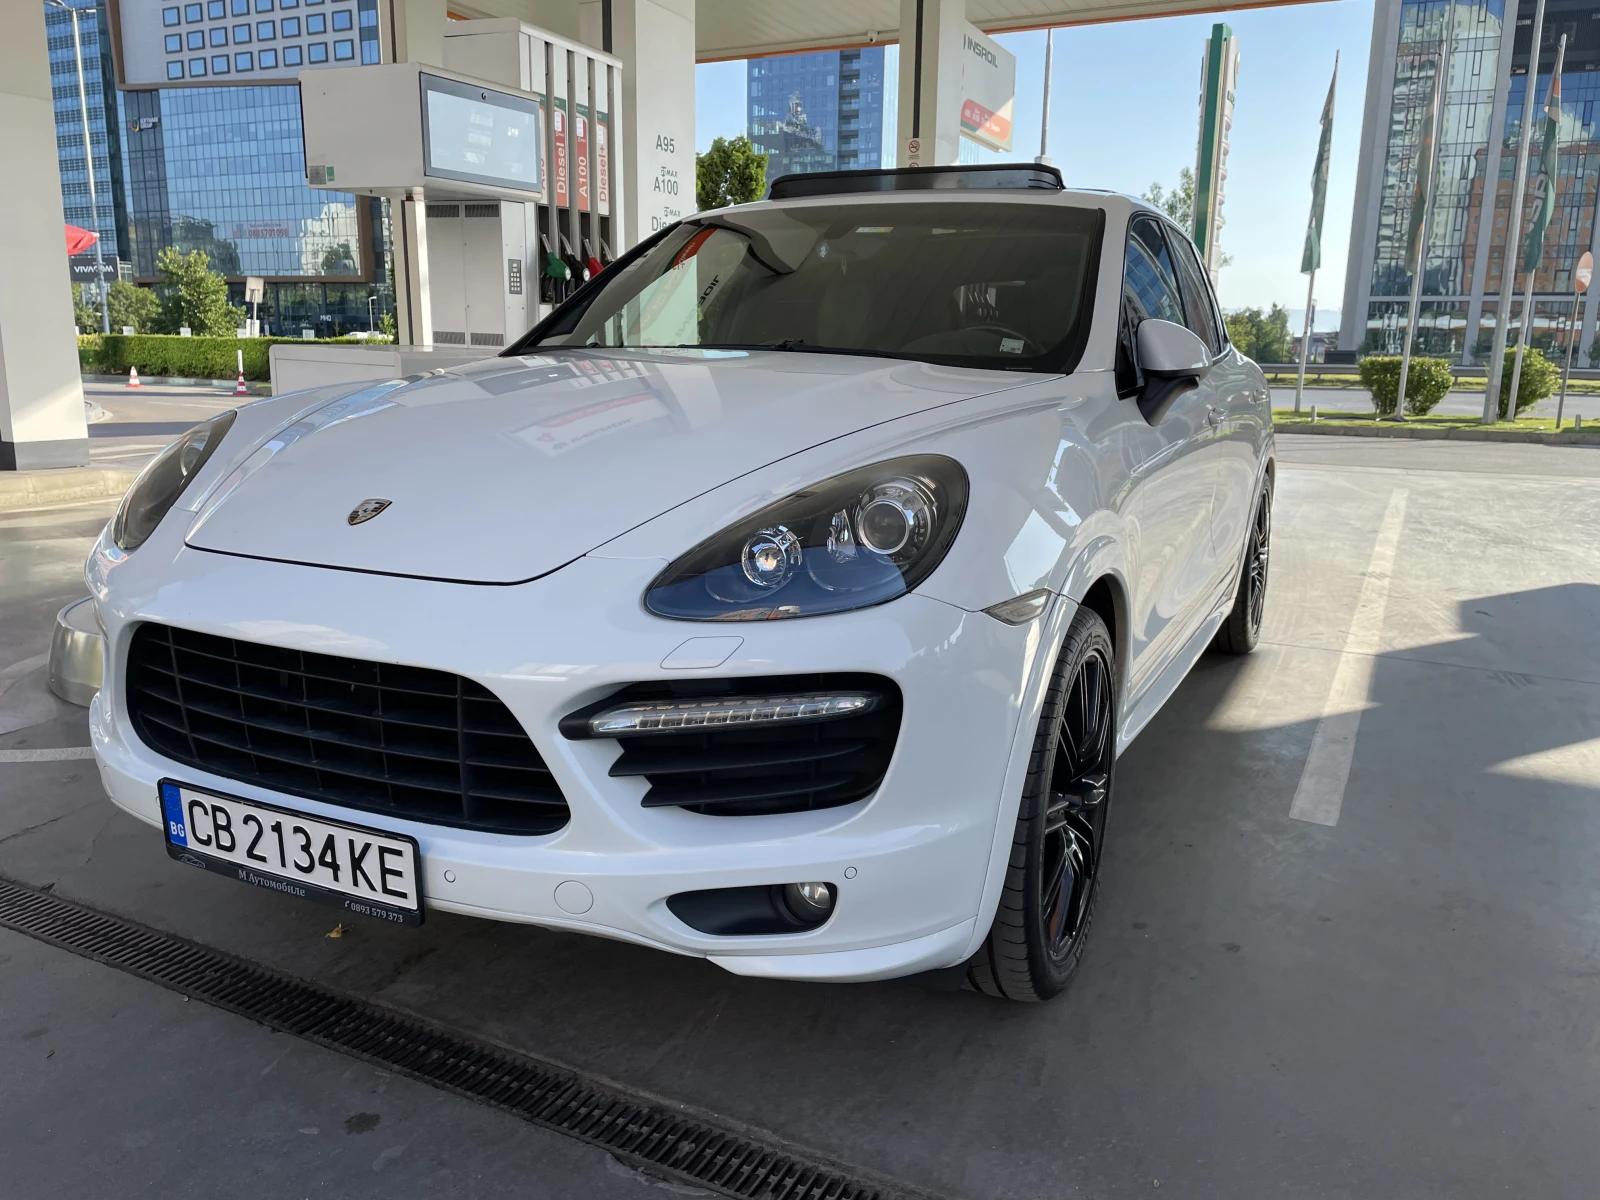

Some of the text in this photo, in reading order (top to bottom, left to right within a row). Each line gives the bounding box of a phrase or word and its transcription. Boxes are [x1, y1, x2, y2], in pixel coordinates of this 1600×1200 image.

[655, 134, 675, 154] A95
[555, 142, 566, 194] Diesel
[578, 156, 587, 198] A100
[598, 144, 607, 202] Diesel+
[653, 176, 679, 196] A100
[170, 820, 185, 838] BG
[350, 902, 404, 923] 0893 579 373
